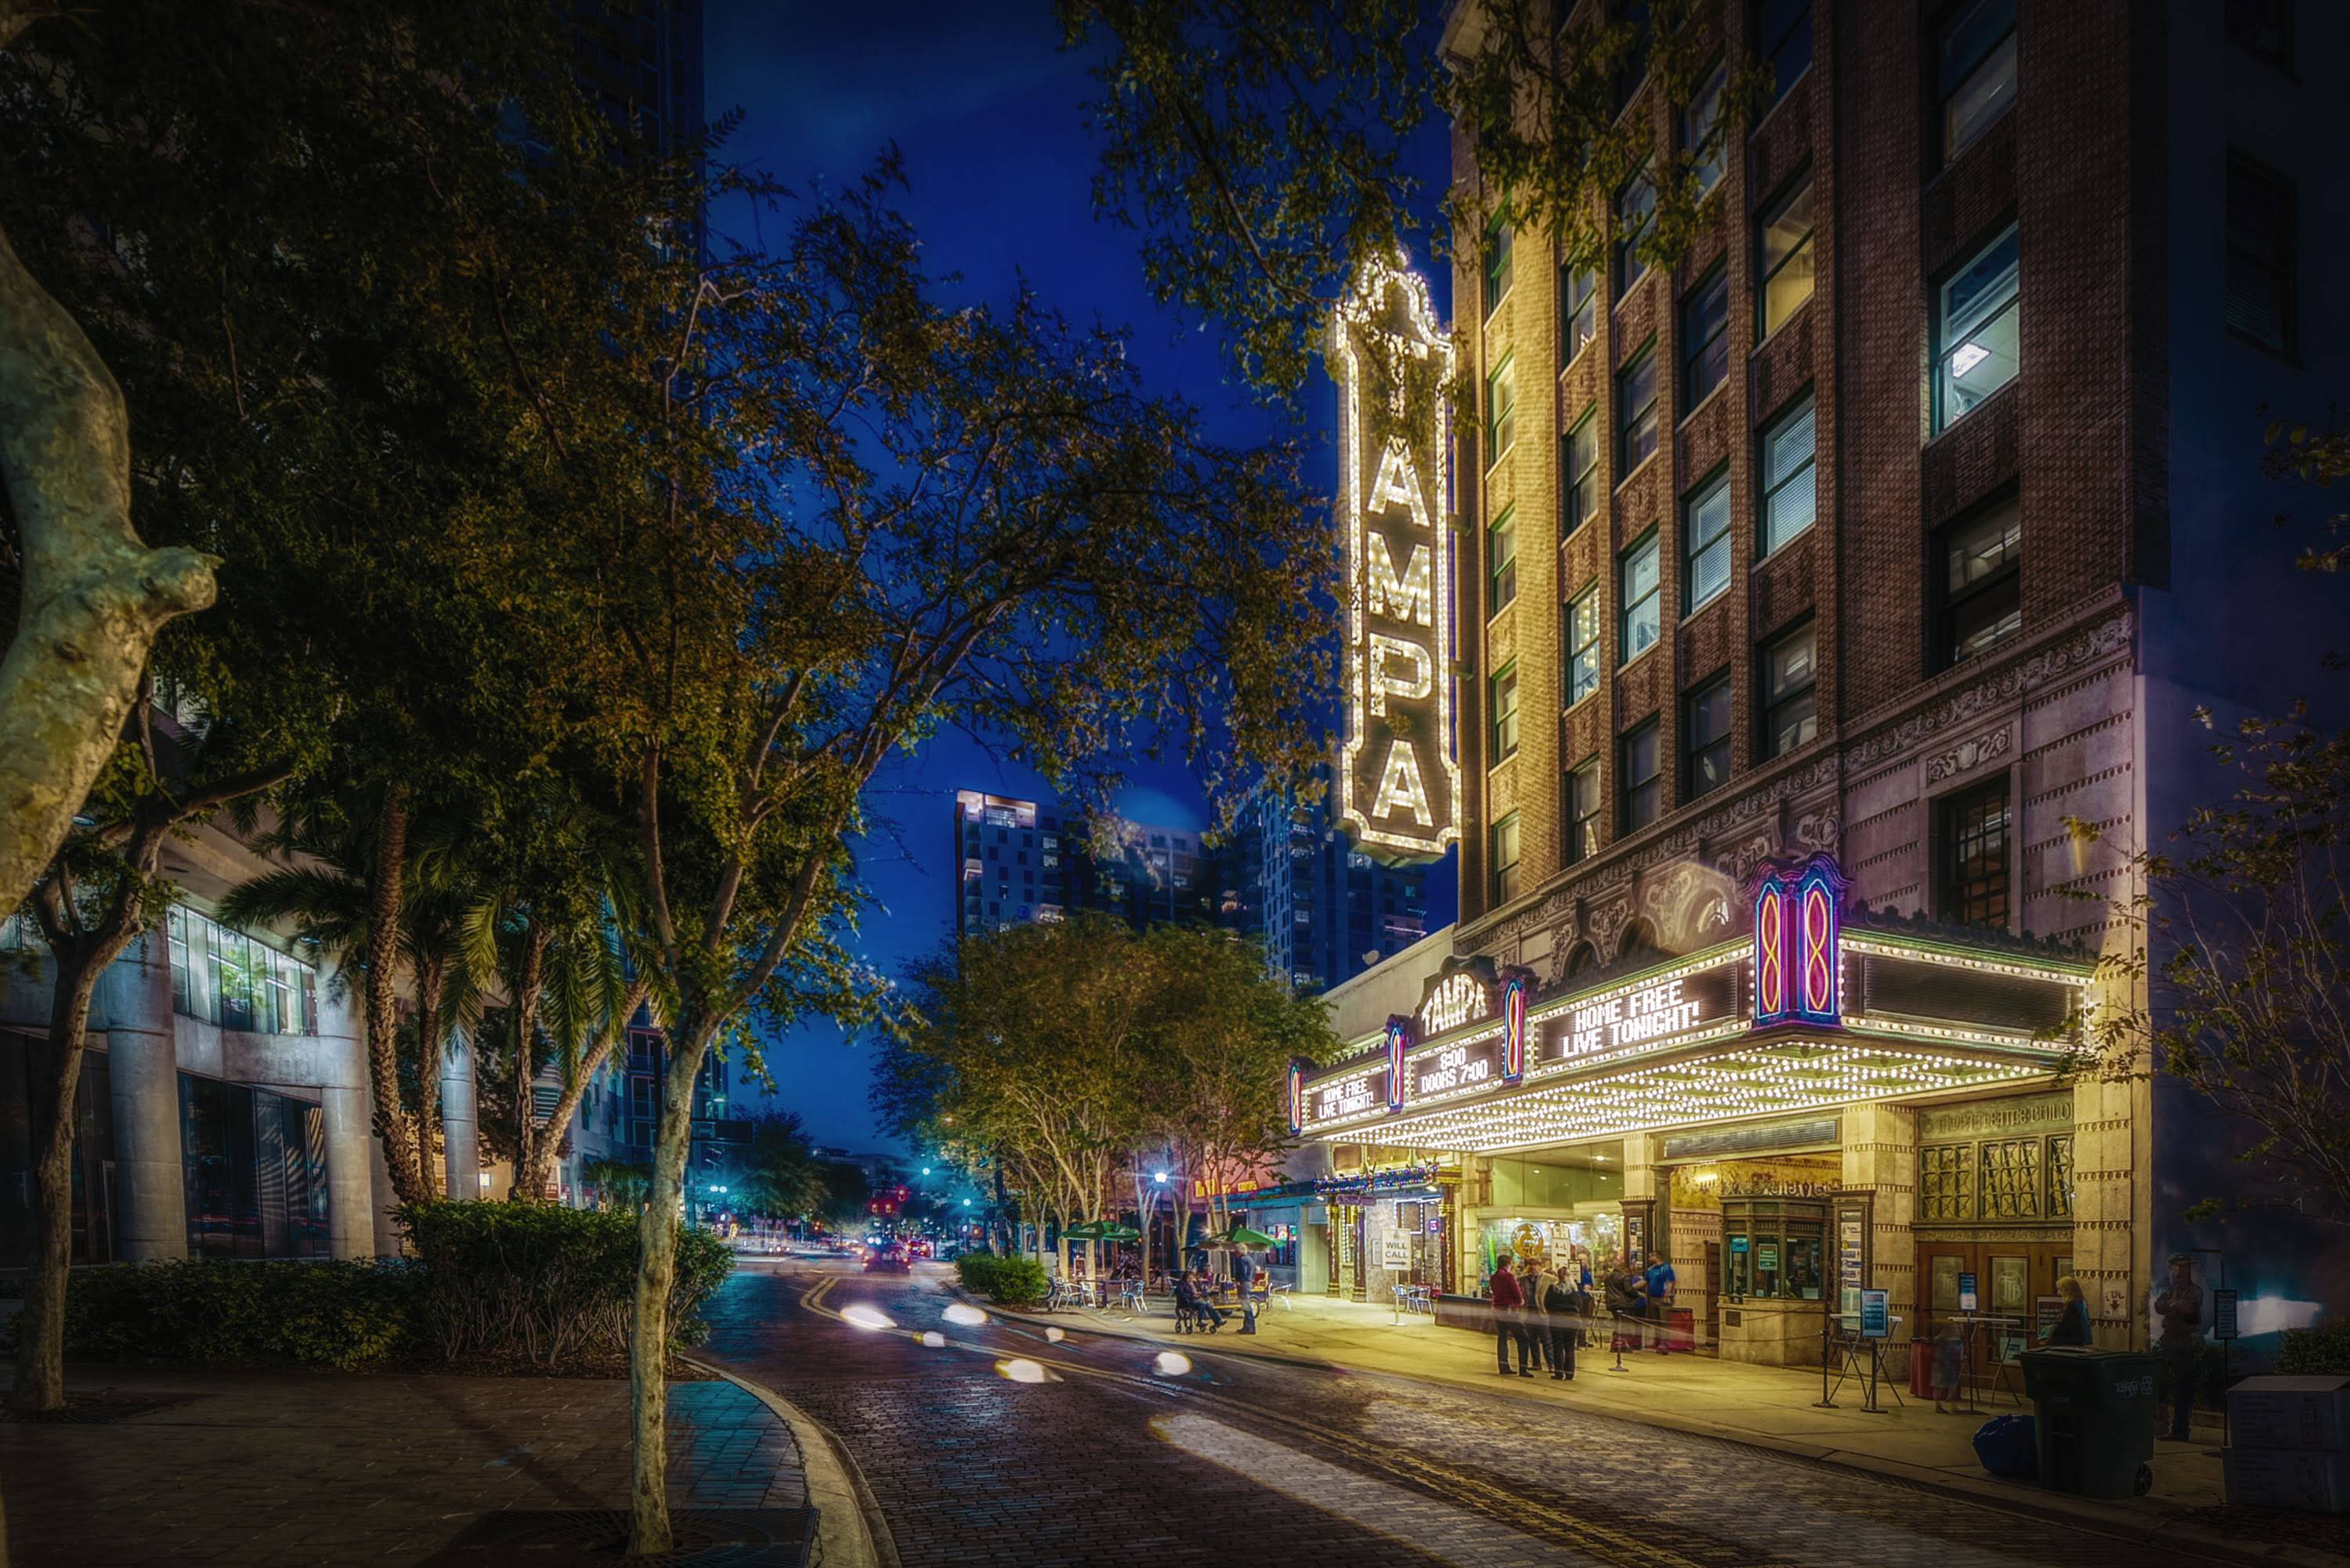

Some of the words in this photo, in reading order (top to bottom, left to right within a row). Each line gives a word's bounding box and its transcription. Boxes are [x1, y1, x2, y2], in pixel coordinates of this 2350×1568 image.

[1368, 332, 1433, 827] TAMPA
[1422, 974, 1487, 1036] TAMPA
[1563, 1027, 1603, 1057] LIVE
[1610, 992, 1700, 1046] TONIGHT!
[1574, 998, 1622, 1033] HOME
[1629, 979, 1683, 1017] FREE
[1421, 1068, 1456, 1093] DOORS
[1459, 1059, 1488, 1084] 7:00
[1440, 1046, 1466, 1070] 8:00
[1318, 1102, 1336, 1119] LIVE
[1338, 1090, 1374, 1115] TONIGHT!
[1324, 1084, 1344, 1104] HOME
[1346, 1078, 1368, 1097] FREE
